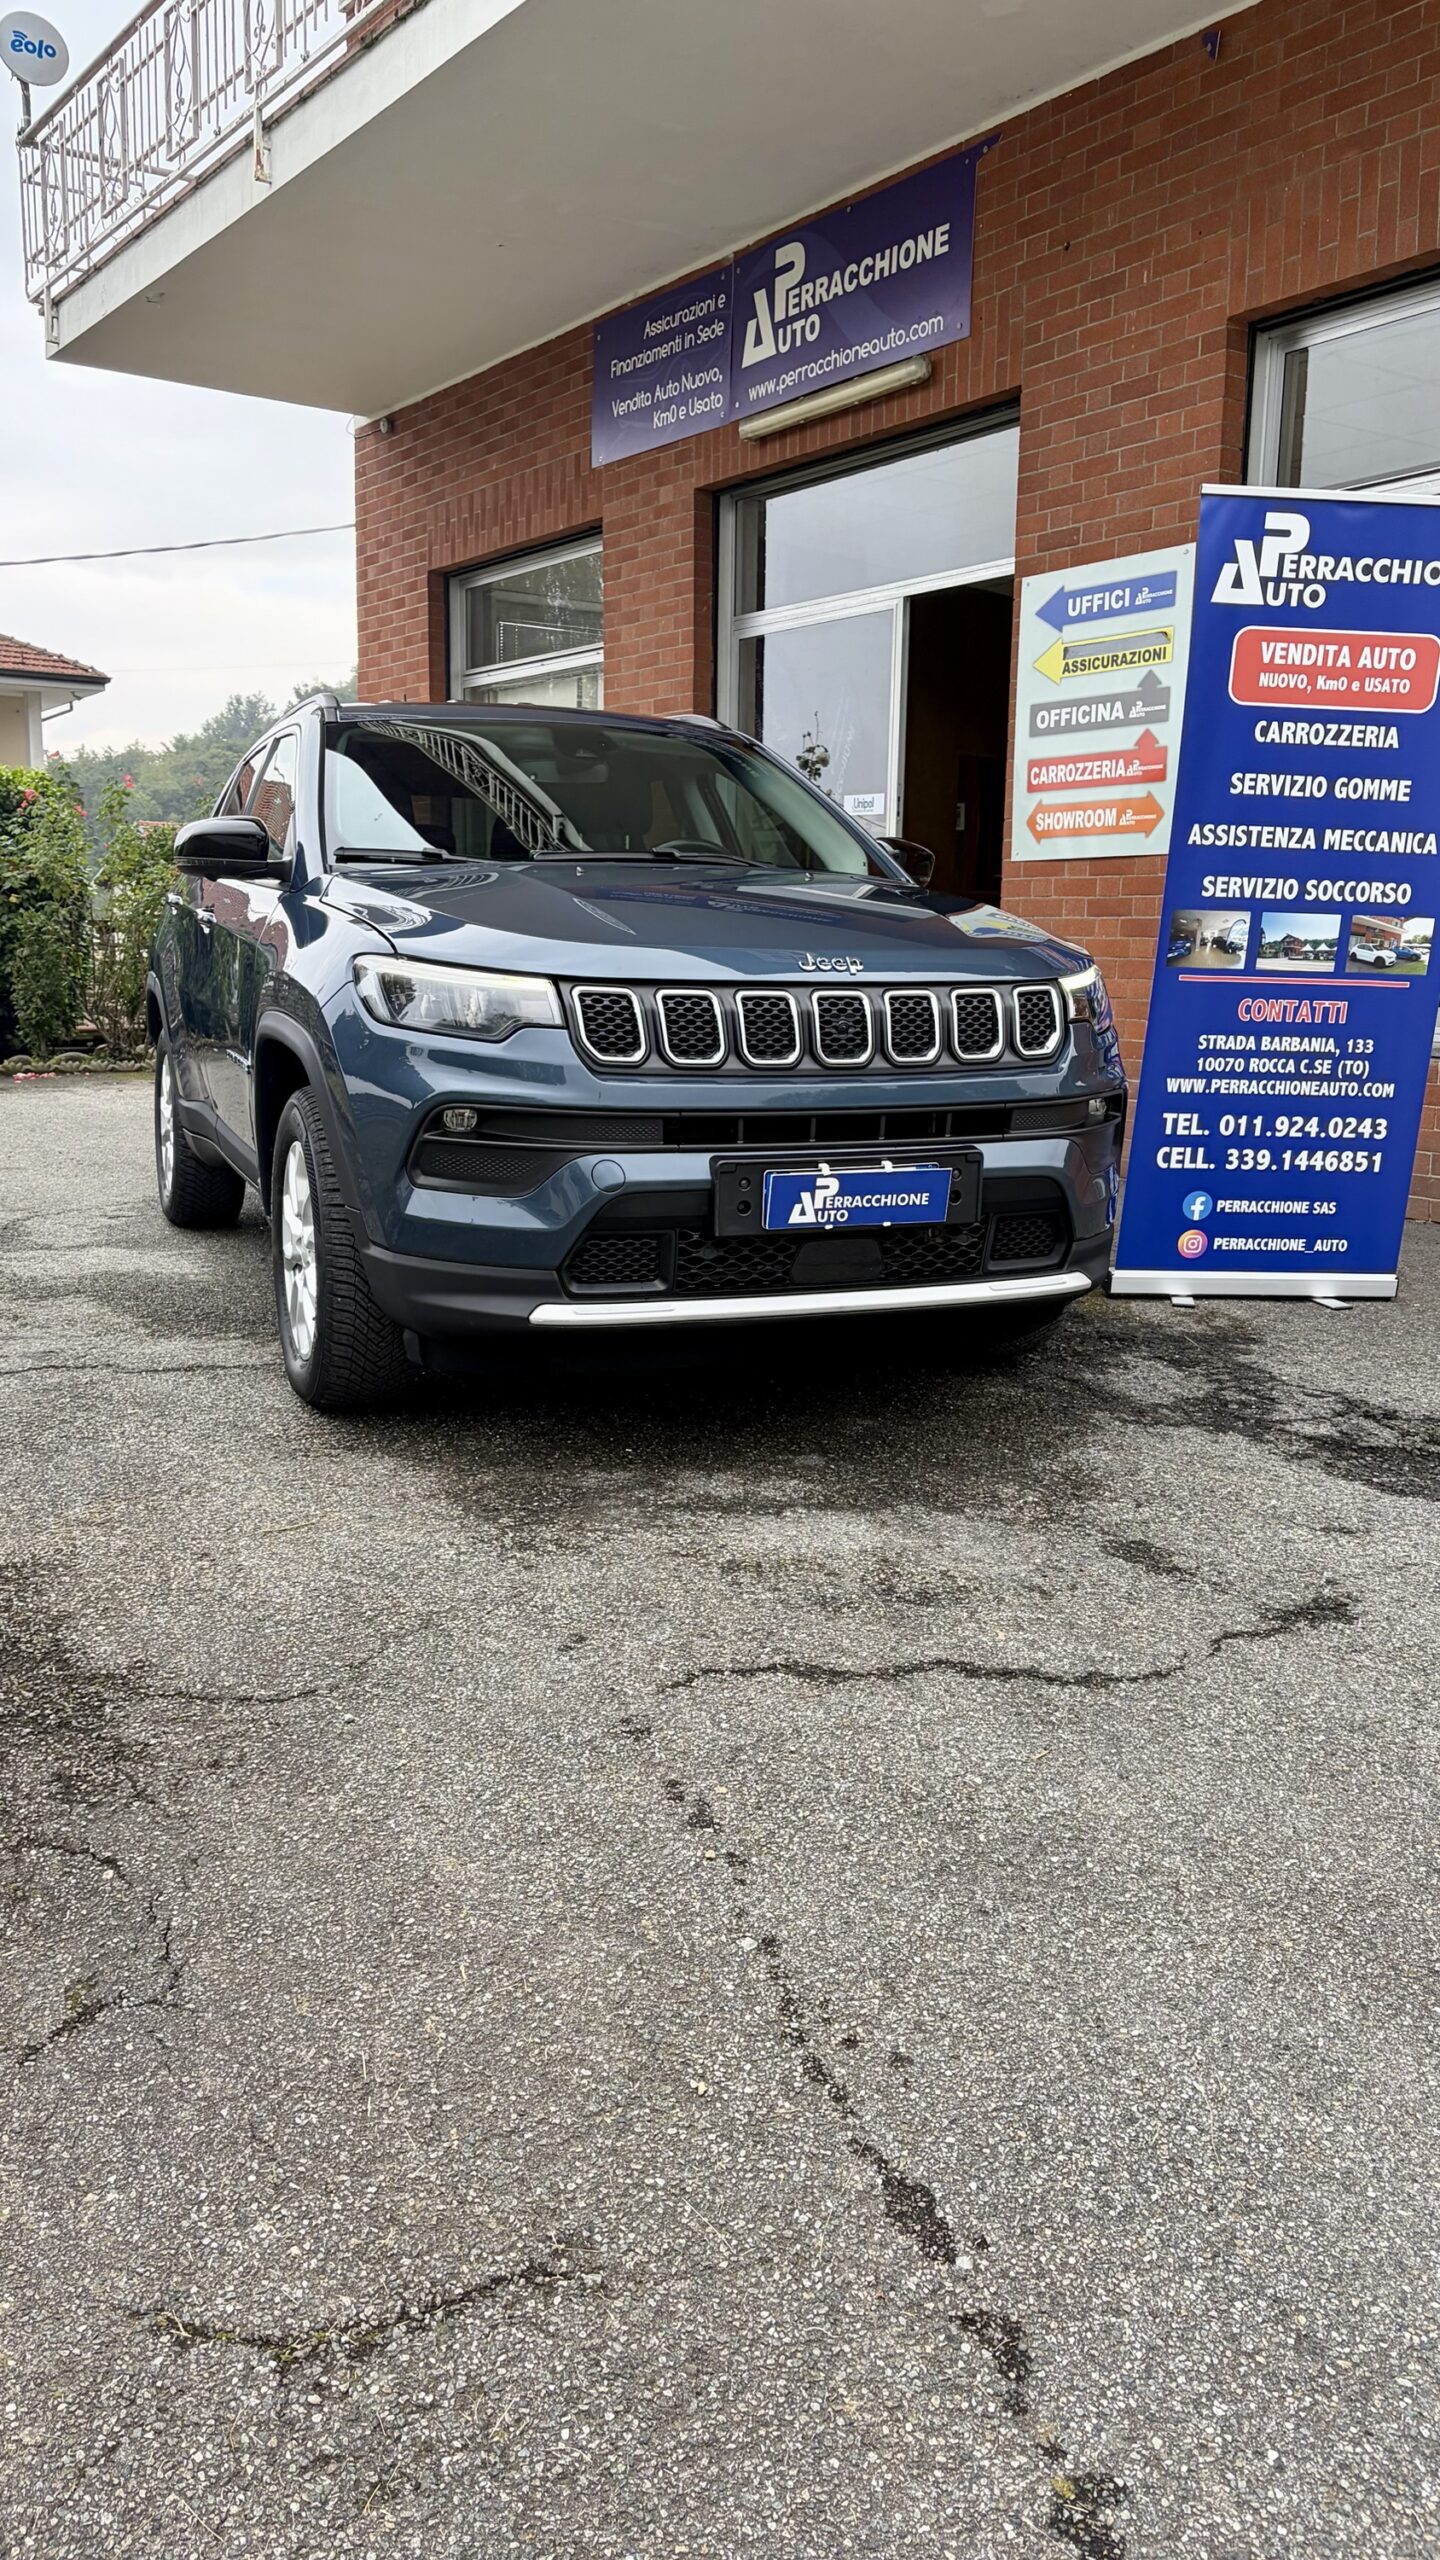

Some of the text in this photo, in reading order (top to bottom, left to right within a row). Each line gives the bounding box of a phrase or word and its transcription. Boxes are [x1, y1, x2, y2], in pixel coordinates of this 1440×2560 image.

[10, 38, 57, 59] eolo
[774, 223, 950, 323] PERRACCHIONE
[643, 293, 726, 340] Assicurazioni e
[742, 288, 821, 369] AUTO
[610, 319, 725, 378] Finanziamenti in Sede
[748, 315, 944, 402] www.perracchioneauto.com
[612, 367, 723, 418] Vendita Auto Nuovo,
[679, 405, 687, 420] e
[689, 391, 723, 417] Usato
[1210, 539, 1327, 609] AUTO
[1067, 587, 1131, 617] UFFICI
[1062, 646, 1167, 675] ASSICURAZIONI
[1261, 641, 1417, 671] VENDITA AUTO
[1258, 671, 1312, 694] NUOVO,
[1351, 680, 1360, 692] e
[1364, 677, 1411, 694] USATO
[1036, 700, 1125, 729] OFFICINA
[1254, 720, 1400, 749] CARROZZERIA
[1030, 758, 1126, 785] CARROZZERIA
[1229, 773, 1412, 802] SERVIZIO GOMME
[1035, 807, 1117, 831] SHOWROOM
[1187, 823, 1438, 855] ASSISTENZA MECCANICA
[1202, 875, 1412, 905] SERVIZIO SOCCORSO
[798, 953, 864, 975] Jeep
[1237, 998, 1349, 1024] CONTATTI
[1198, 1035, 1375, 1057] STRADA BARBANIA, 133
[1197, 1057, 1370, 1079] 10070 ROCCA C.SE (TO)
[1166, 1078, 1395, 1099] WWW.PERRACCHIONEAUTO.COM
[1163, 1113, 1388, 1140] TEL. 011.924.0243
[1156, 1146, 1383, 1173] CELL. 339.1446851
[813, 1177, 930, 1209] PERRACCHIONE
[1216, 1199, 1337, 1215] PERRACCHIONE SAS
[788, 1192, 849, 1225] AUTO
[1213, 1237, 1348, 1254] PERRACCHIONE_AUTO
